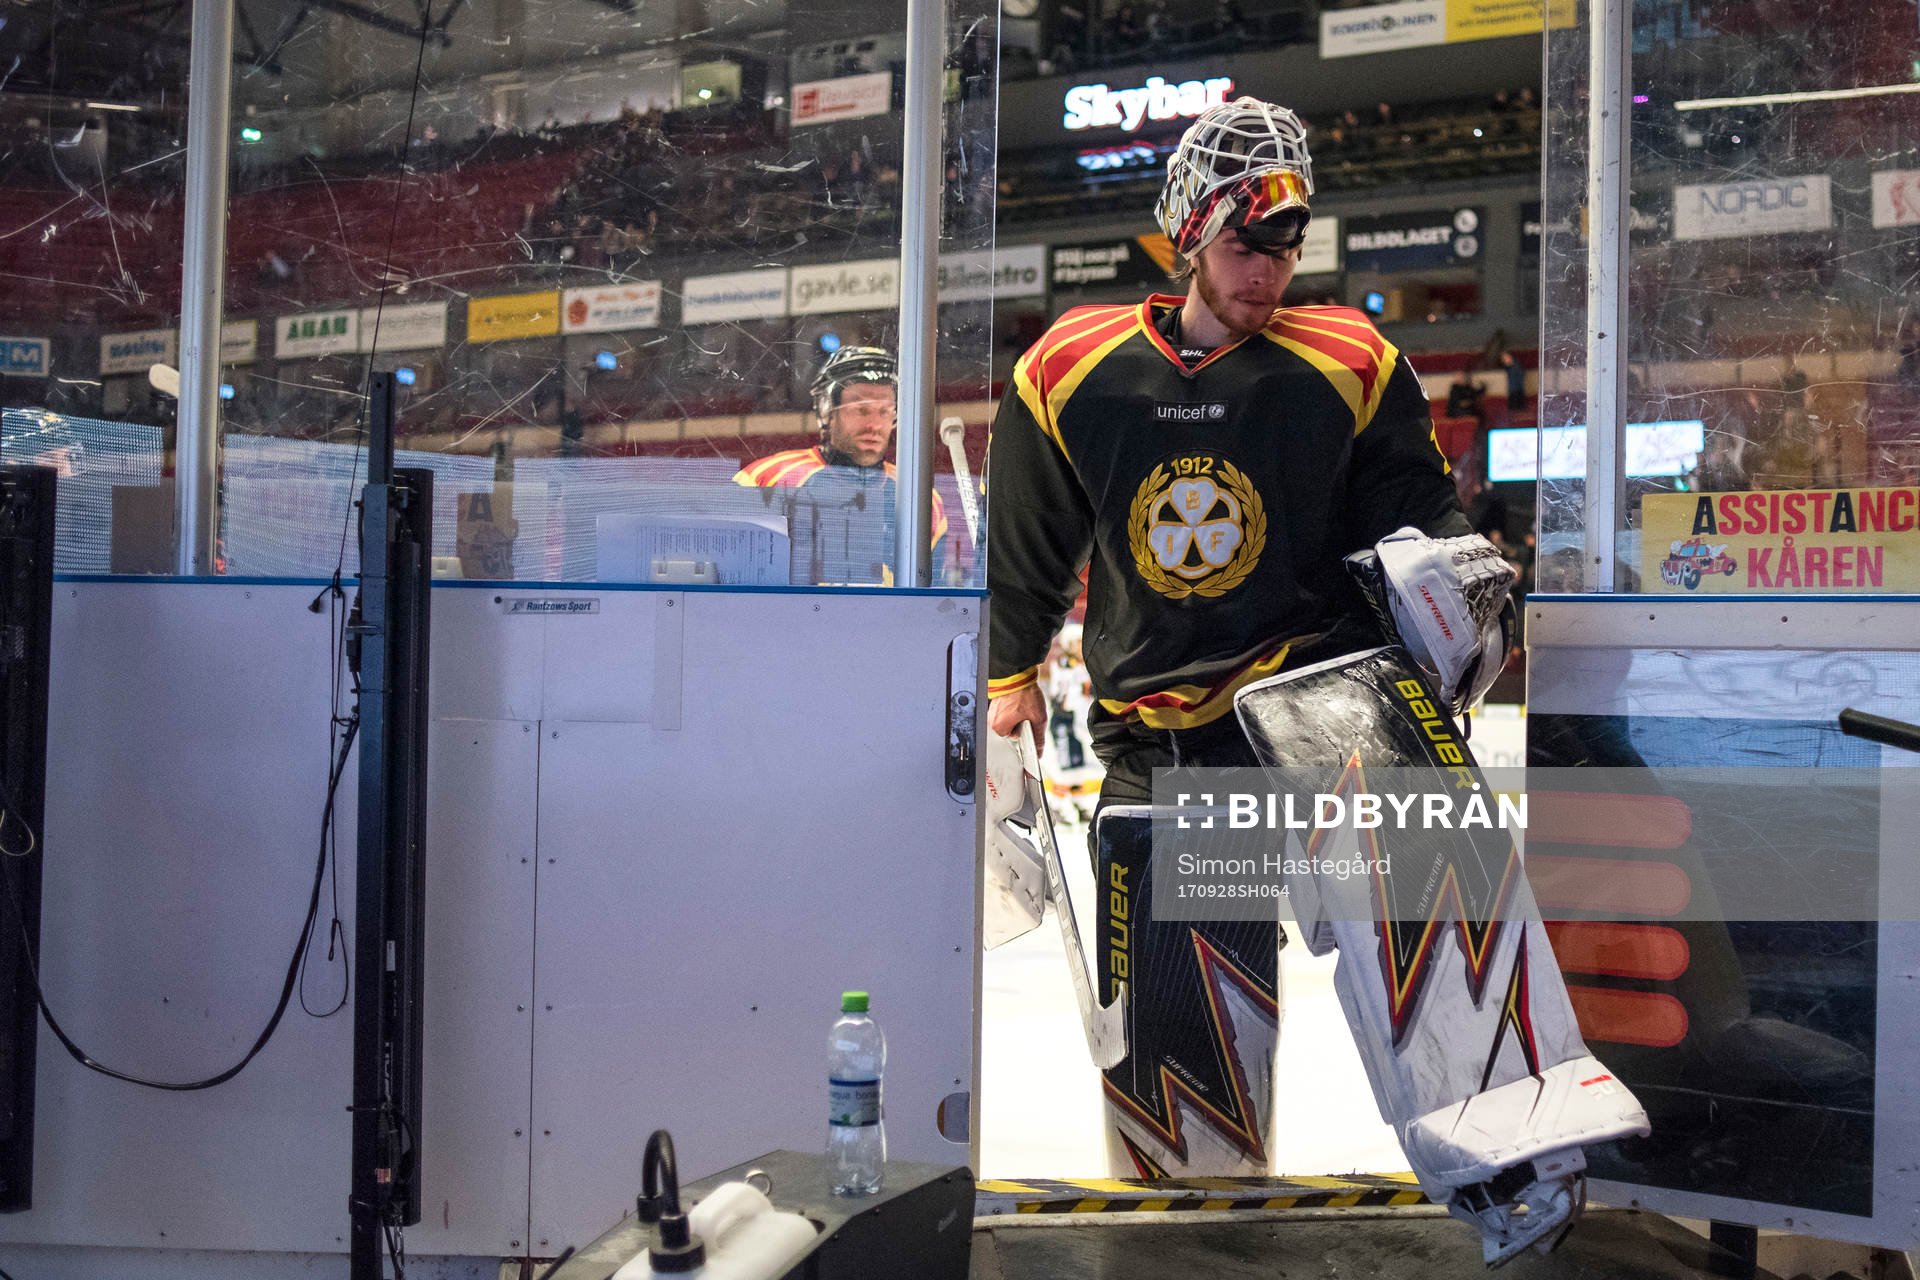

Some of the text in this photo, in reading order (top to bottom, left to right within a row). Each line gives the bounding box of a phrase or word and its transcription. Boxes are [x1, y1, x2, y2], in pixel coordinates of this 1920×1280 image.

[1063, 76, 1235, 133] Skybar
[1701, 178, 1808, 216] NORDIC
[1347, 226, 1452, 251] BILBOLAGET
[1179, 349, 1206, 357] SHL
[1157, 405, 1206, 420] unicef
[1170, 456, 1215, 477] 1912
[1185, 490, 1200, 511] B
[1692, 490, 1920, 536] ASSISTANC
[1210, 531, 1225, 551] F
[1747, 536, 1883, 588] KÅREN
[568, 601, 592, 612] Sport
